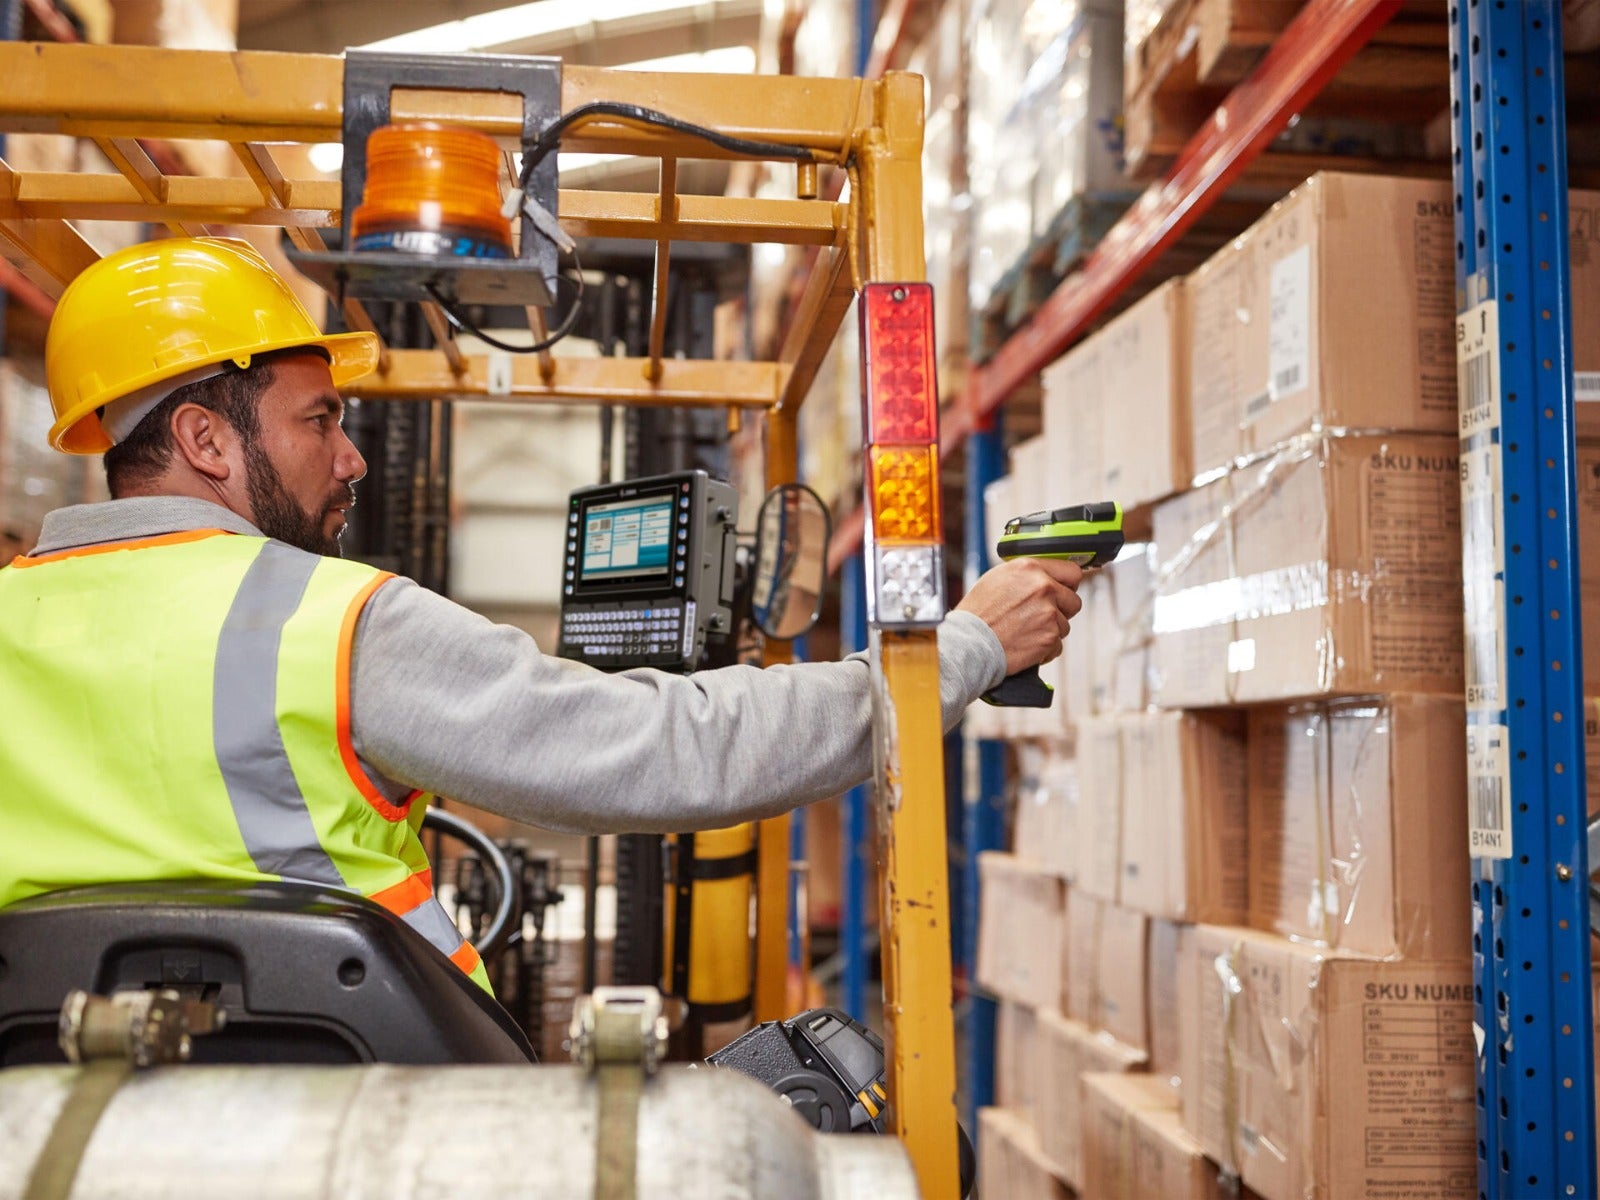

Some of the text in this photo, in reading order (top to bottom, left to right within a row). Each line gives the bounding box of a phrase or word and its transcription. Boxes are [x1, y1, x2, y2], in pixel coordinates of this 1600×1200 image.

[1462, 406, 1491, 429] B14N4
[1371, 454, 1411, 471] SKU
[1472, 832, 1502, 847] B14N1
[1365, 982, 1473, 1001] SKU NUMB
